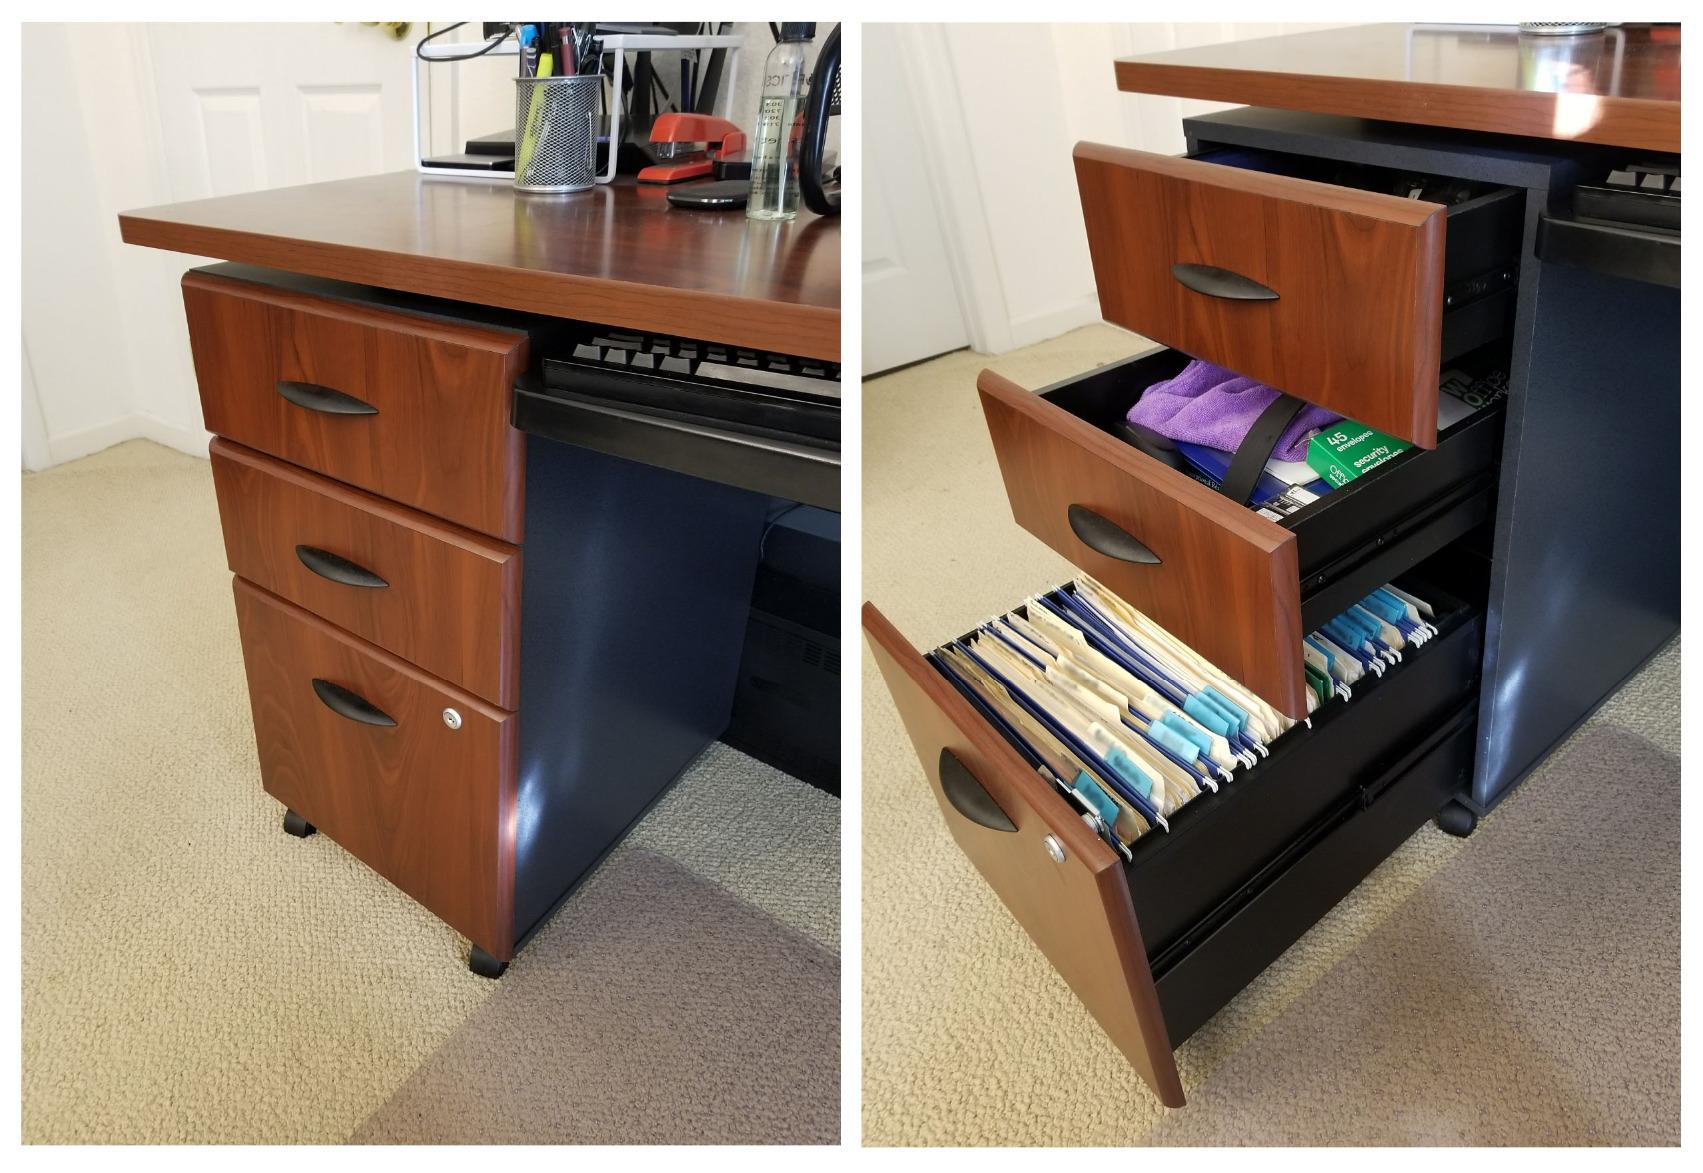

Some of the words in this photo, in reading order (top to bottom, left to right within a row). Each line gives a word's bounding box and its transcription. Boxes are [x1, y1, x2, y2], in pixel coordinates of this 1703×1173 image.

[1327, 432, 1348, 446] 45
[1336, 430, 1374, 452] envelopes
[1353, 445, 1390, 468] security
